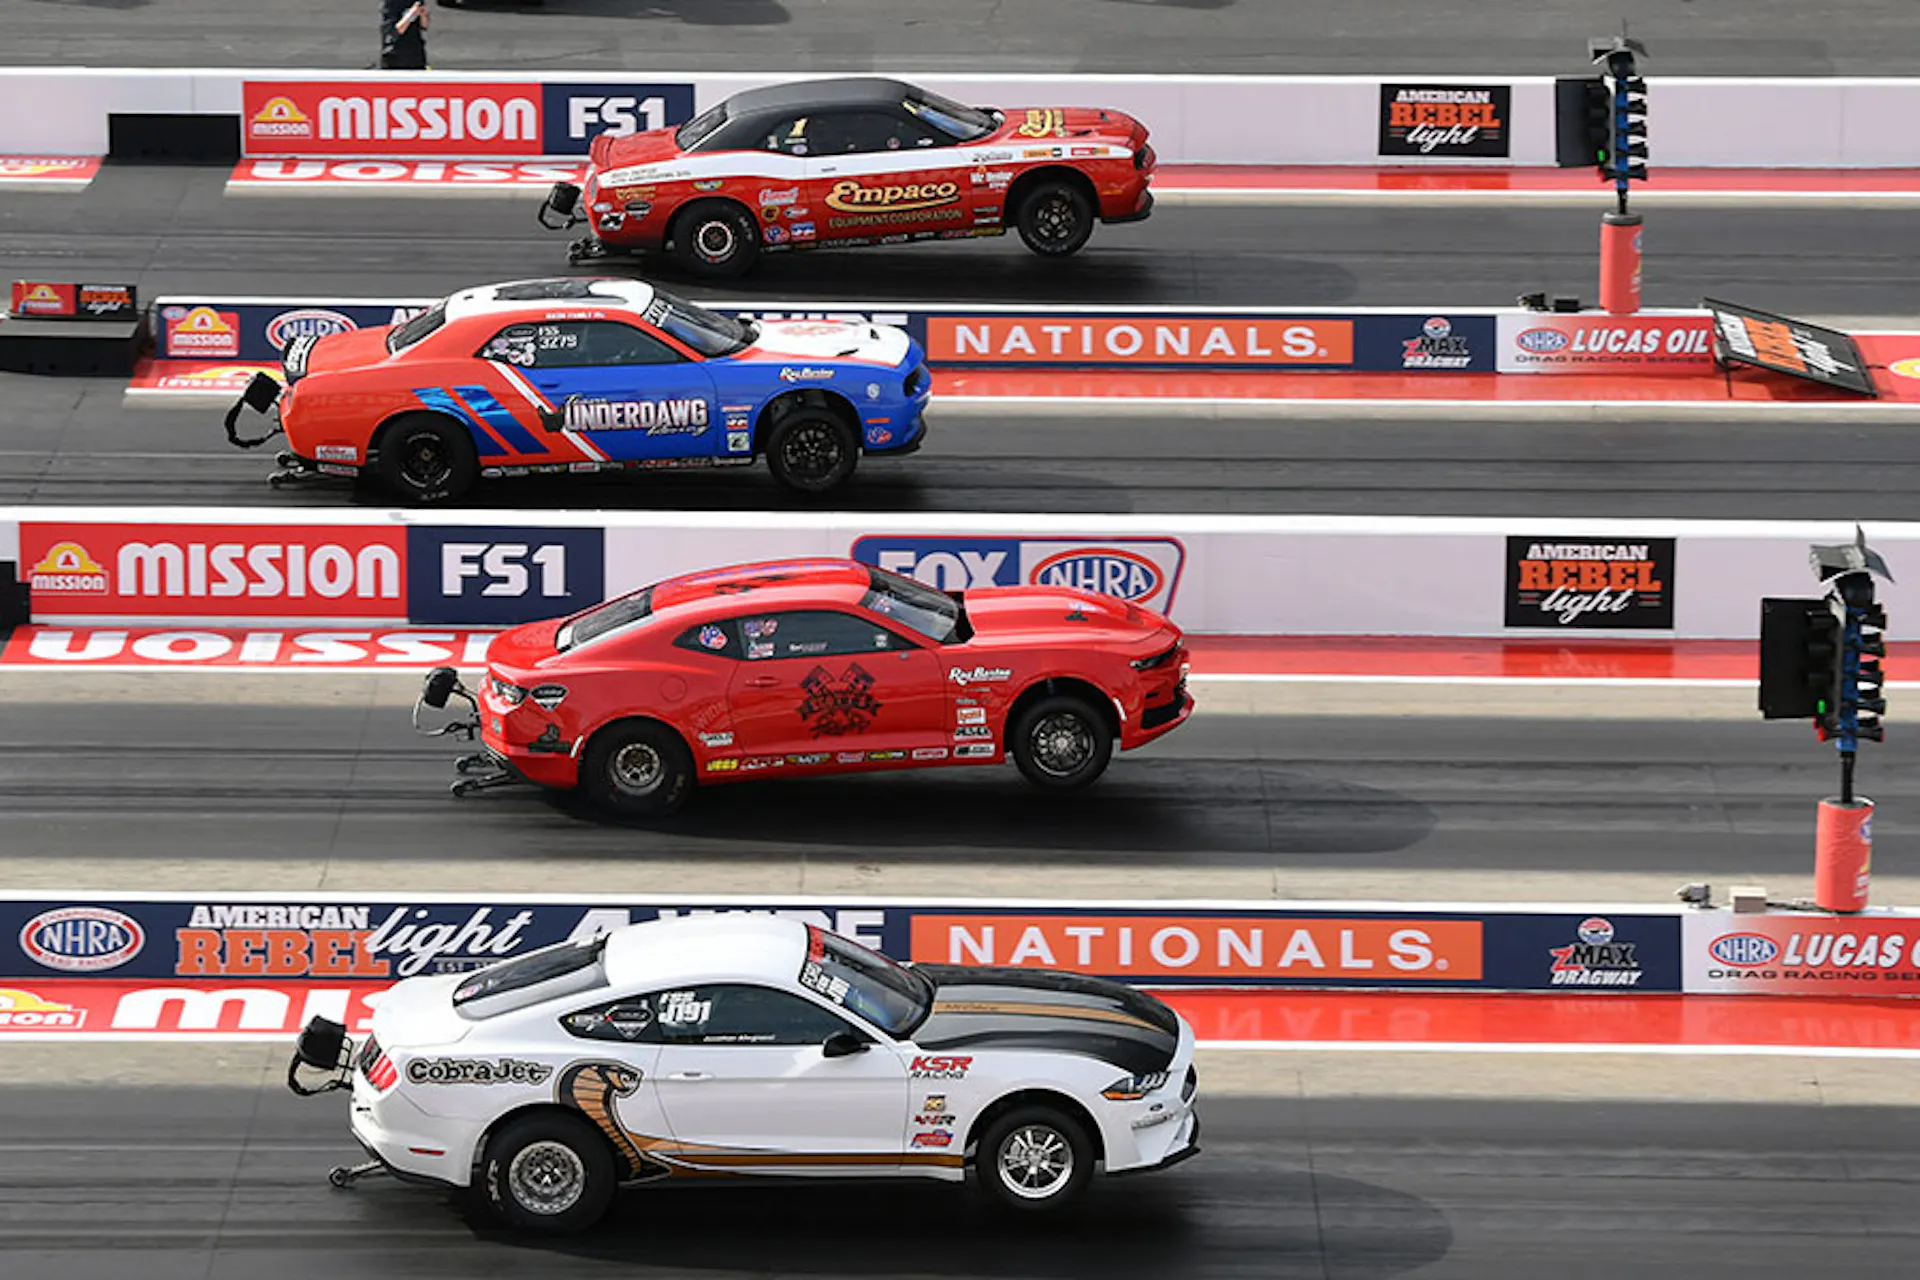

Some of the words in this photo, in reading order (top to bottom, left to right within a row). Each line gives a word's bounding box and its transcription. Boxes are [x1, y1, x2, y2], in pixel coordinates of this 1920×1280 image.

[1396, 89, 1490, 103] AMERICAN
[318, 97, 537, 140] MISSION
[568, 96, 665, 138] FS1
[1389, 103, 1500, 127] REBEL
[1406, 122, 1480, 153] light
[824, 180, 960, 213] Empaco
[1571, 328, 1663, 353] LUCAS
[1665, 330, 1714, 353] OIL
[563, 400, 708, 431] UNDERDAWG
[1526, 544, 1648, 561] AMERICAN
[118, 543, 399, 598] MISSION
[442, 544, 570, 598] FS1
[1050, 557, 1148, 600] NHRA
[1518, 560, 1663, 592] REBEL
[1540, 585, 1634, 625] light
[188, 905, 369, 930] AMERICAN
[43, 920, 124, 955] NHRA
[176, 930, 390, 976] REBEL
[365, 906, 533, 977] light
[1718, 936, 1777, 963] NHRA
[1782, 934, 1905, 968] LUCAS
[1551, 969, 1643, 985] DRAGWAY
[1709, 970, 1777, 980] DRAG
[1783, 971, 1877, 981] RACING
[911, 1056, 973, 1071] KSR
[911, 1071, 965, 1079] RACING
